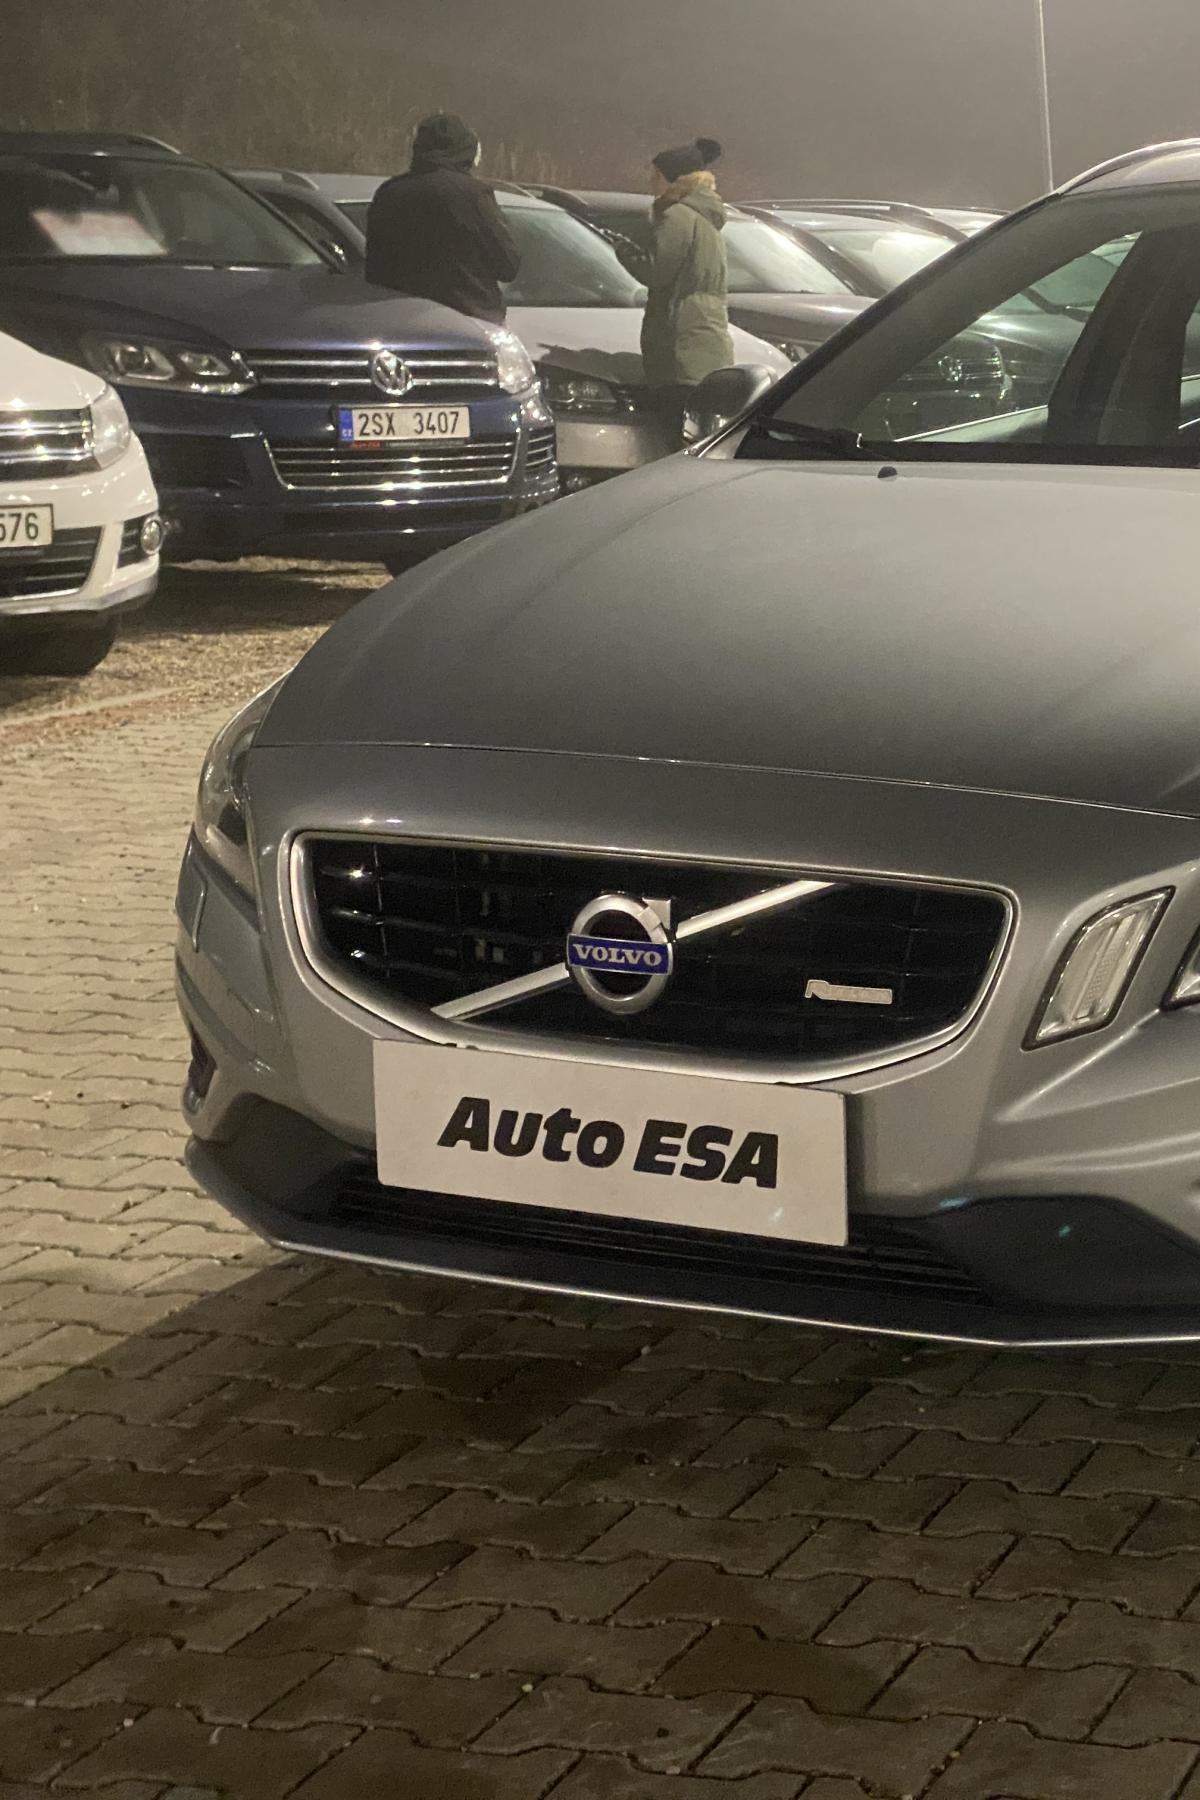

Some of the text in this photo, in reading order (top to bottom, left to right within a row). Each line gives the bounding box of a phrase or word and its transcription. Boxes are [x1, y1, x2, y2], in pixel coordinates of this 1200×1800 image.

[358, 410, 460, 437] 2SX 3407
[572, 943, 662, 967] VOLVO
[437, 1096, 778, 1189] Auto ESA
